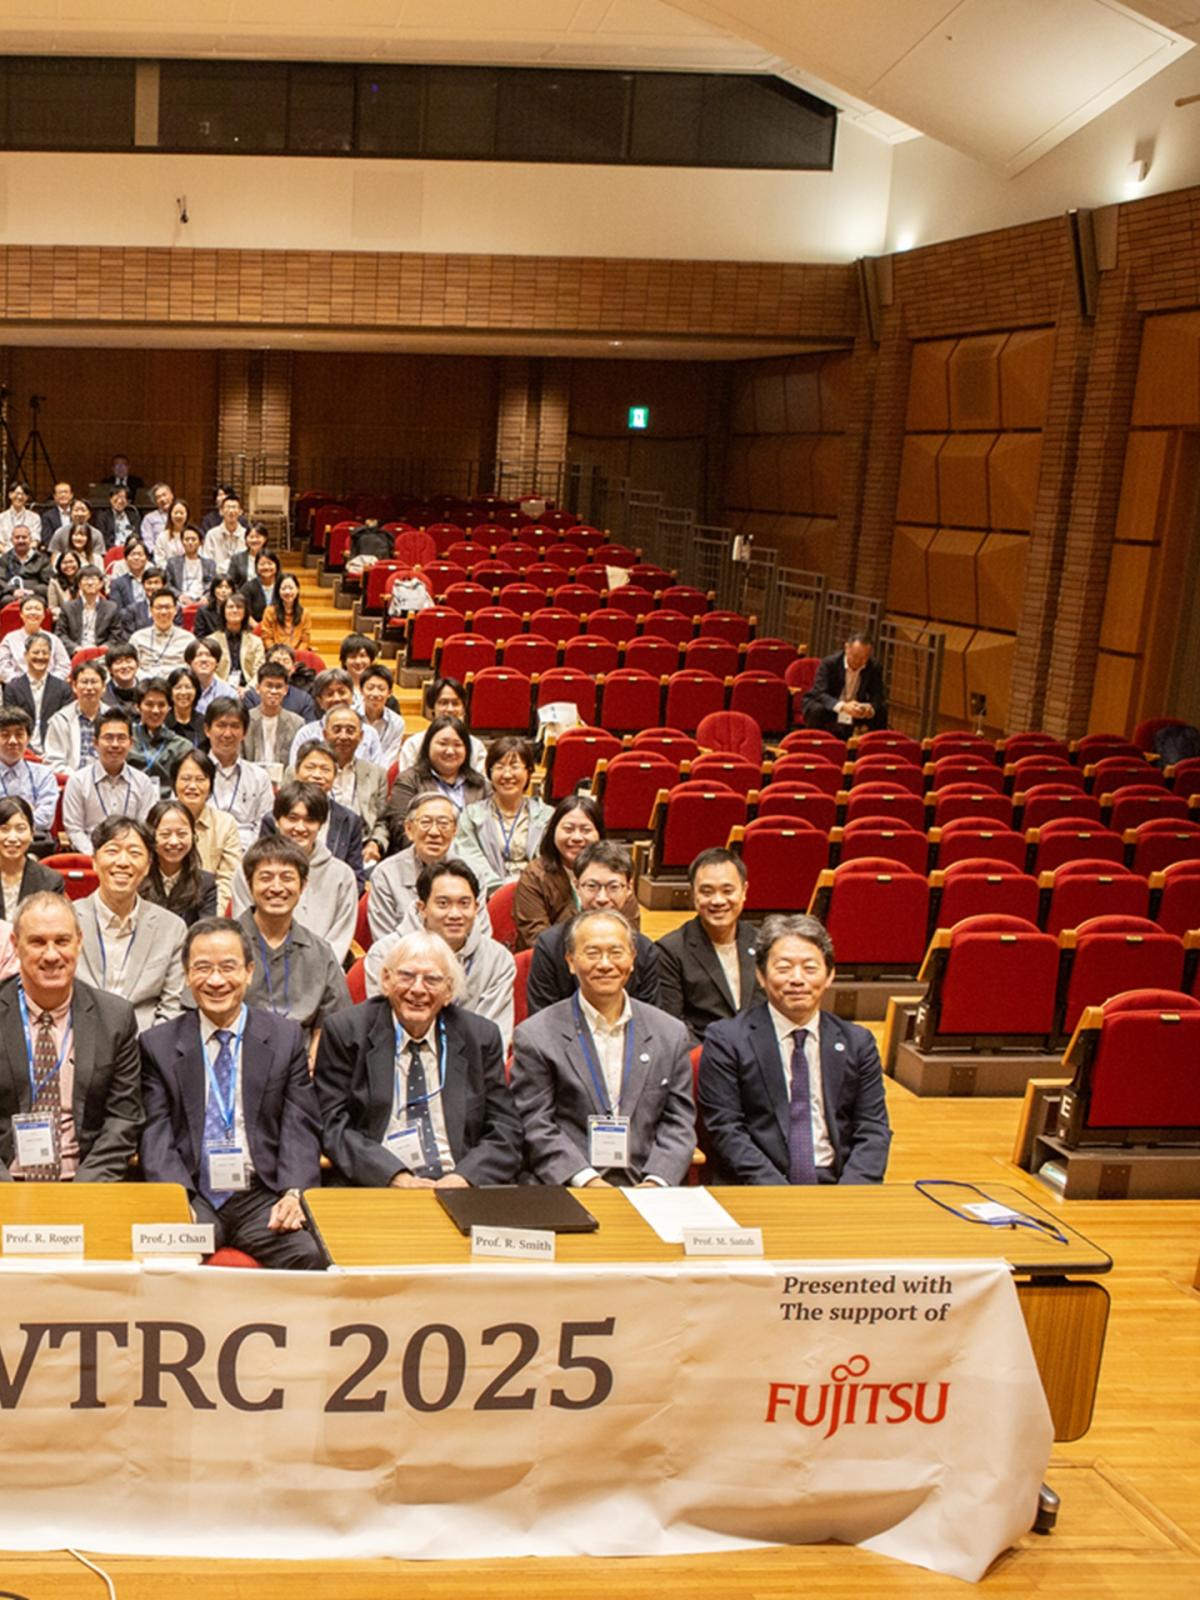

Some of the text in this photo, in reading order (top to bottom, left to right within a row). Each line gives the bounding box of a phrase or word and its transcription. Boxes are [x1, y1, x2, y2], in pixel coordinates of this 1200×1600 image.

[916, 1006, 927, 1024] F
[1060, 1095, 1072, 1118] E
[6, 1233, 32, 1243] Prof.
[35, 1233, 46, 1243] R.
[140, 1233, 207, 1246] Prof. J. Chan
[476, 1237, 552, 1252] Prof. R. Smith
[693, 1237, 755, 1246] Prof. M. Satoh
[783, 1275, 952, 1295] Presented with
[779, 1302, 951, 1324] The support of
[322, 1316, 616, 1413] 2025
[765, 1354, 950, 1439] FUJITSU
